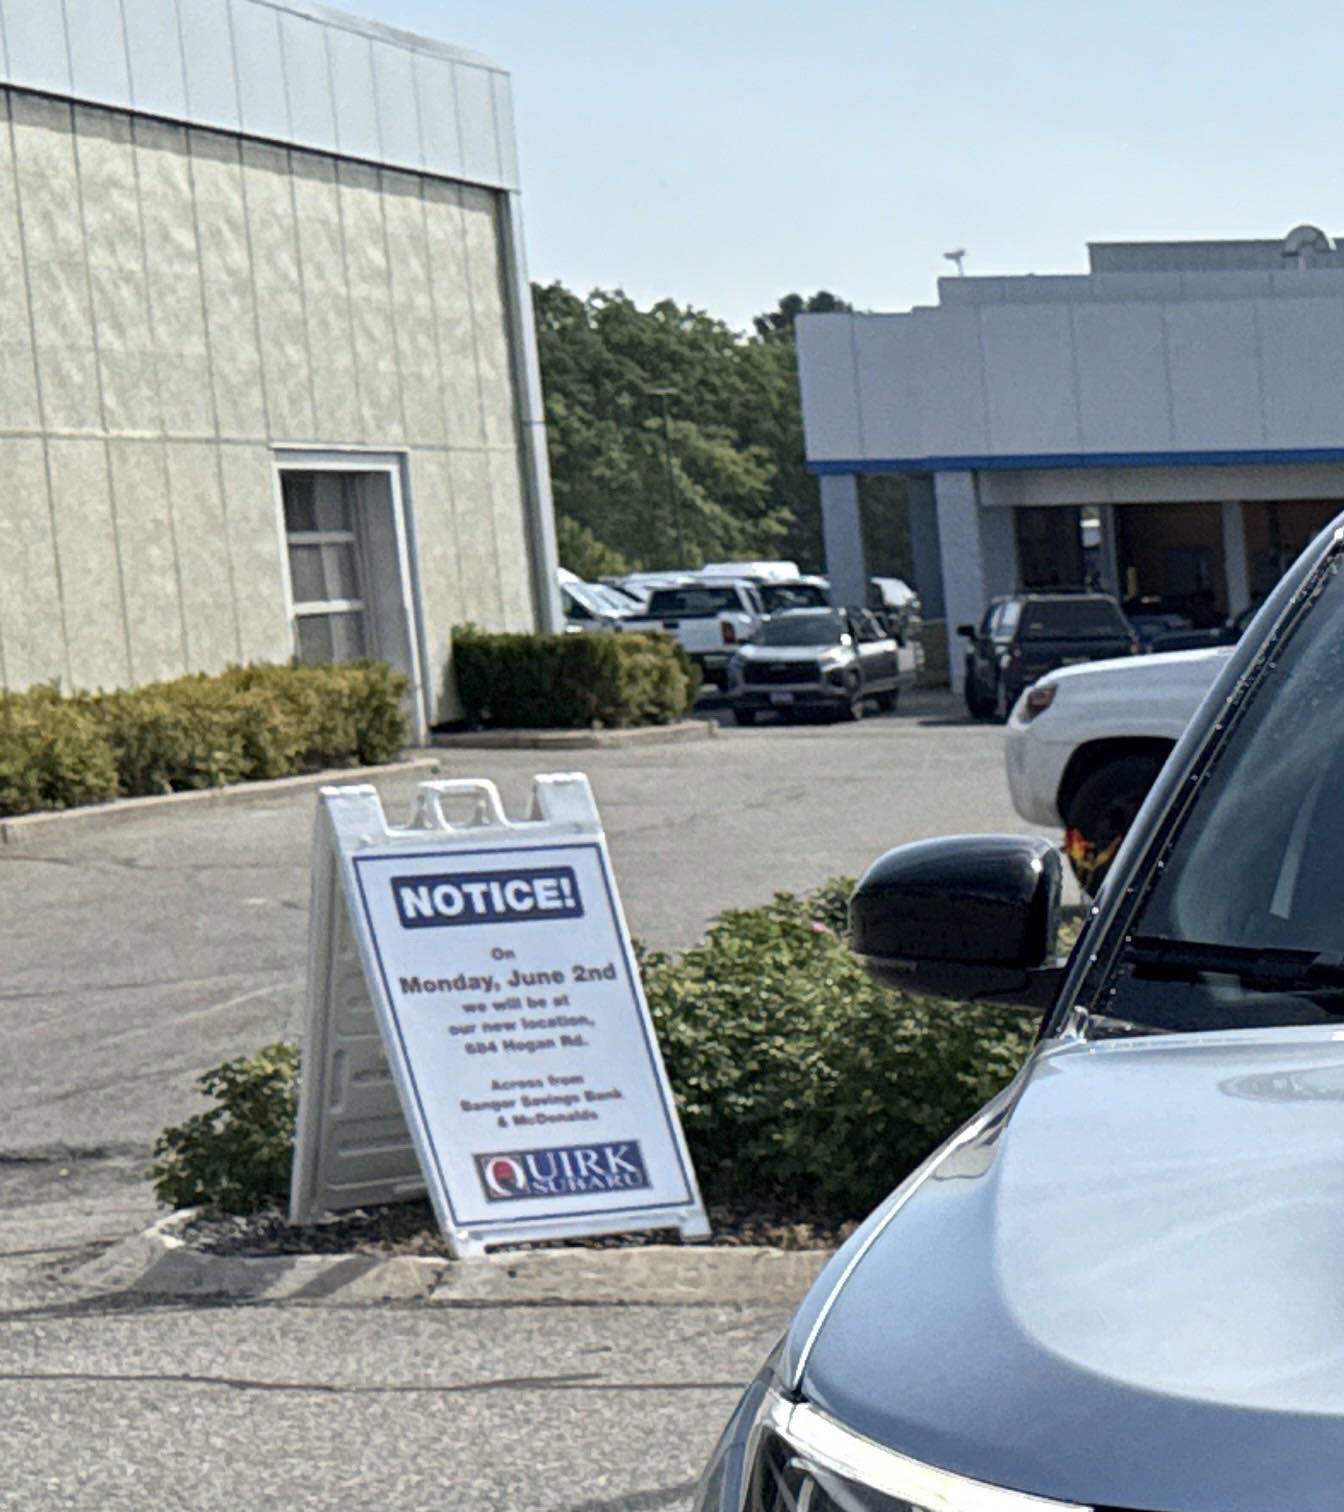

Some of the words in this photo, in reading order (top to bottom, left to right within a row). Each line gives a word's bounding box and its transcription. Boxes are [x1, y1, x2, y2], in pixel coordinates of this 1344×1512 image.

[400, 877, 576, 918] NOTICE!
[491, 947, 515, 960] On
[399, 973, 501, 994] Monday,
[508, 968, 564, 987] June
[571, 963, 617, 982] 2nd
[462, 1002, 486, 1013] we
[492, 997, 522, 1011] will
[526, 995, 547, 1008] be
[553, 994, 570, 1006] at
[448, 1024, 476, 1036] our
[482, 1021, 516, 1033] new
[502, 1038, 555, 1053] Hogan
[560, 1034, 589, 1047] Rd.
[491, 1079, 544, 1090] Across
[548, 1074, 584, 1086] from
[584, 1087, 623, 1102] Bank
[484, 1145, 638, 1197] QUIRK
[530, 1170, 643, 1194] SUBARU
